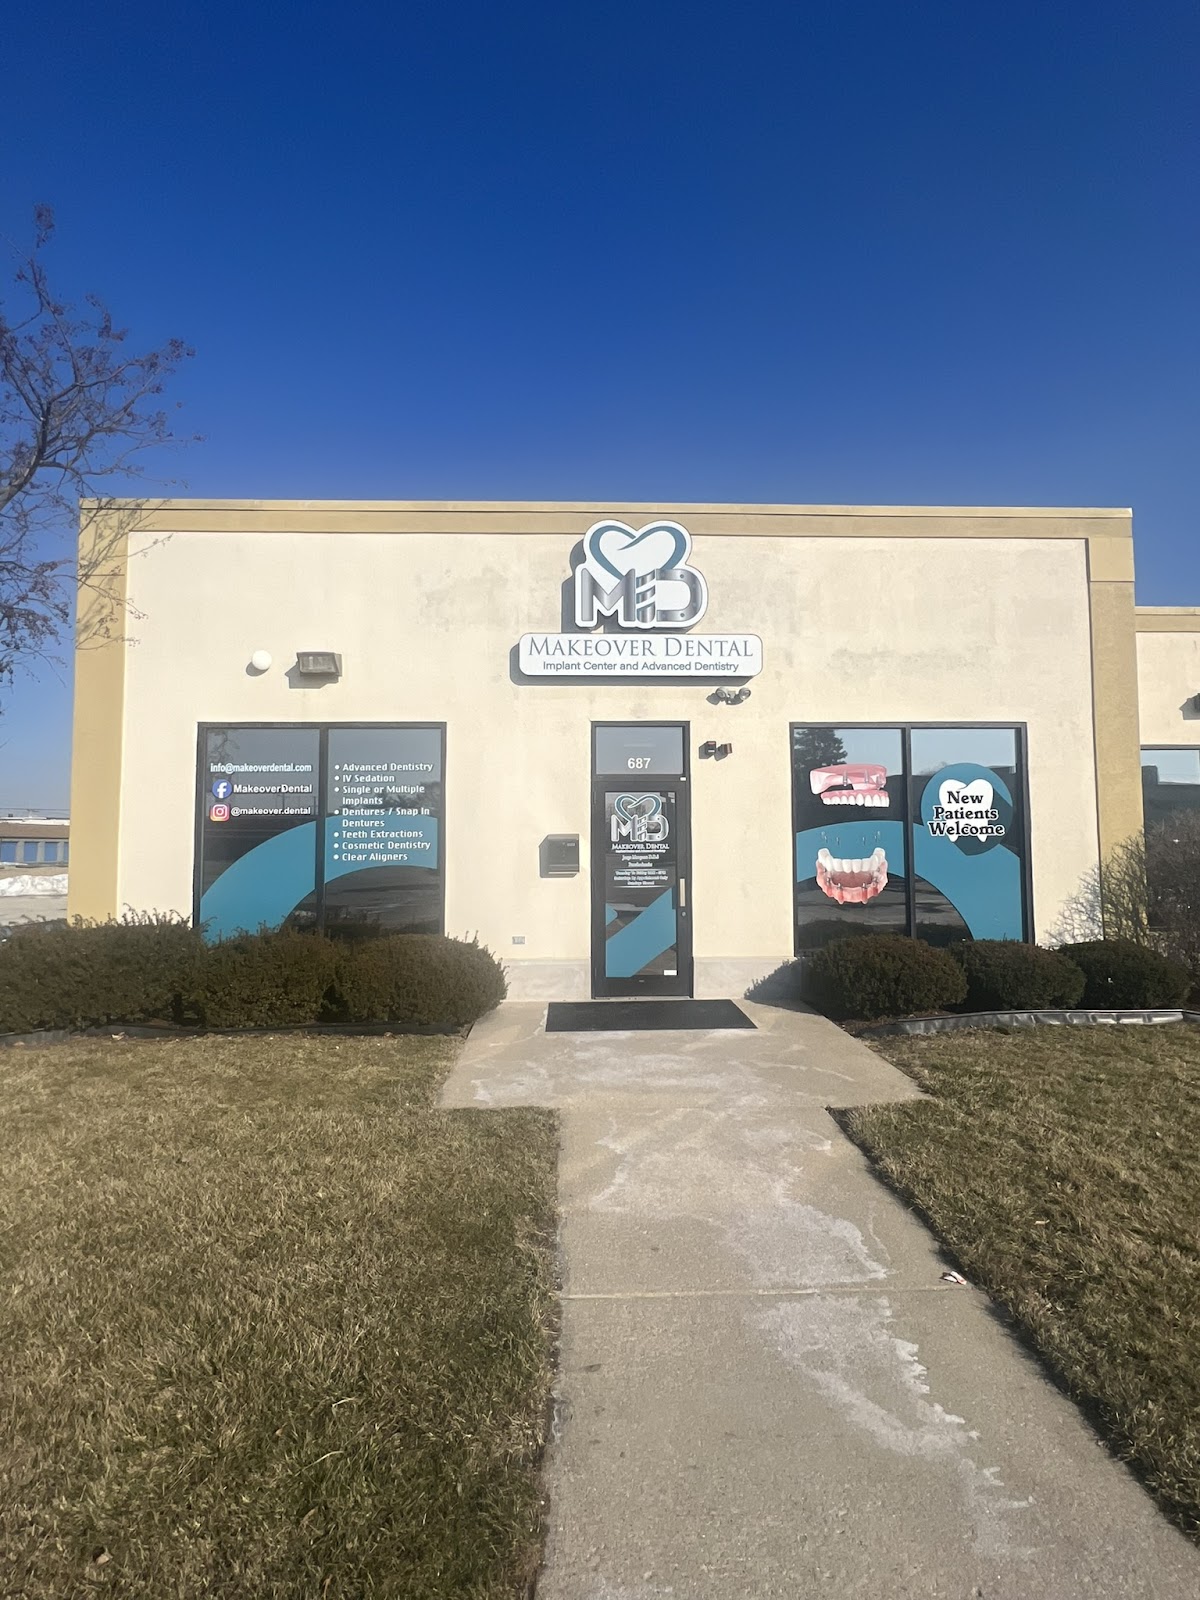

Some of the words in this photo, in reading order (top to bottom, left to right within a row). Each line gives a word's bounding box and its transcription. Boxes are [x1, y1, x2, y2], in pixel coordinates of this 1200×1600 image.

[528, 637, 656, 656] MAKEOVER
[664, 637, 753, 657] DENTAL
[543, 661, 580, 671] Implant
[583, 661, 617, 671] Center
[619, 661, 639, 671] and
[641, 661, 691, 671] Advanced
[694, 661, 739, 673] Dentistry
[342, 763, 388, 772] Advanced
[390, 763, 434, 772] Dentistry
[627, 757, 651, 769] 687
[210, 762, 312, 775] info@makeoverdental.com
[342, 775, 352, 783] IV
[354, 775, 395, 783] Sedation
[342, 786, 371, 795] Single
[386, 786, 425, 794] Multiple
[342, 797, 383, 806] Implants
[947, 790, 984, 804] New
[231, 807, 311, 817] @makeover.dental
[342, 808, 385, 816] Dentures
[396, 808, 419, 817] Snap
[421, 808, 430, 816] In
[934, 806, 998, 820] Patients
[342, 820, 385, 828] Dentures
[928, 821, 1005, 835] Welcome
[342, 831, 368, 839] Teeth
[370, 830, 424, 839] Extractions
[342, 842, 385, 850] Cosmetic
[387, 842, 431, 850] Dentistry
[342, 853, 367, 861] Clear
[369, 853, 408, 862] Aligners
